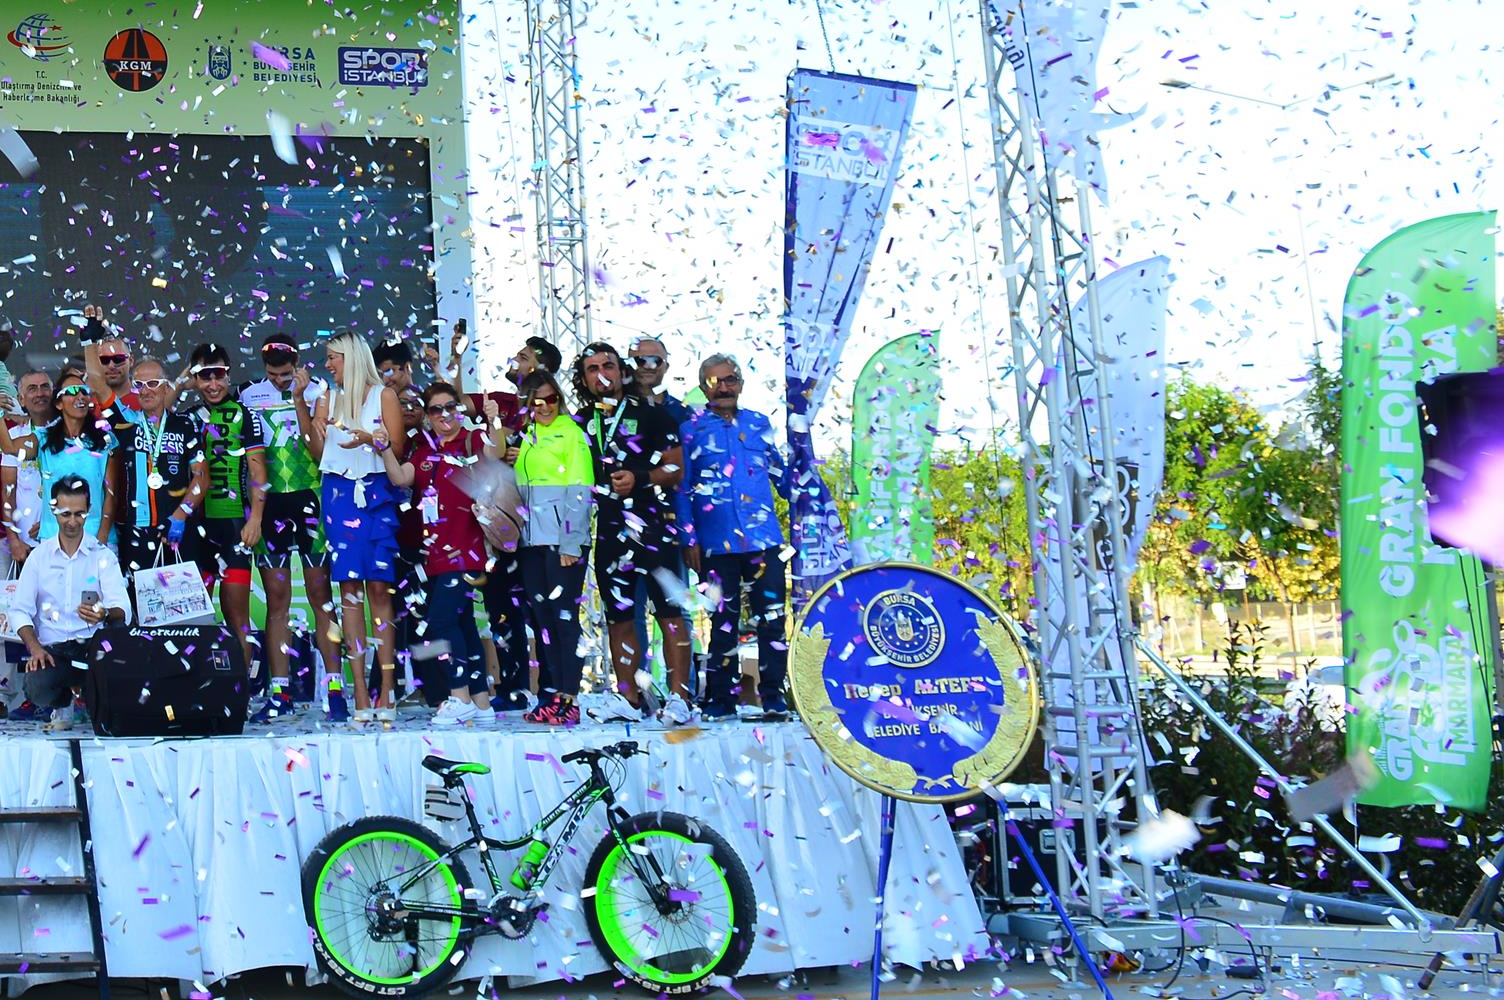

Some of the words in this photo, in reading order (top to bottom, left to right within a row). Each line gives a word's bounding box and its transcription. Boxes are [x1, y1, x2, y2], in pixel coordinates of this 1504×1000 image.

[253, 47, 316, 60] RSA
[344, 51, 421, 70] SPOR
[119, 60, 152, 71] KGM
[36, 71, 47, 79] T.C.
[3, 93, 44, 103] Haberleme
[1378, 290, 1416, 453] FONDO
[1378, 466, 1416, 598] GRAN
[883, 594, 916, 606] BURSA
[844, 683, 902, 699] Reep
[868, 723, 921, 738] ELEDİYE
